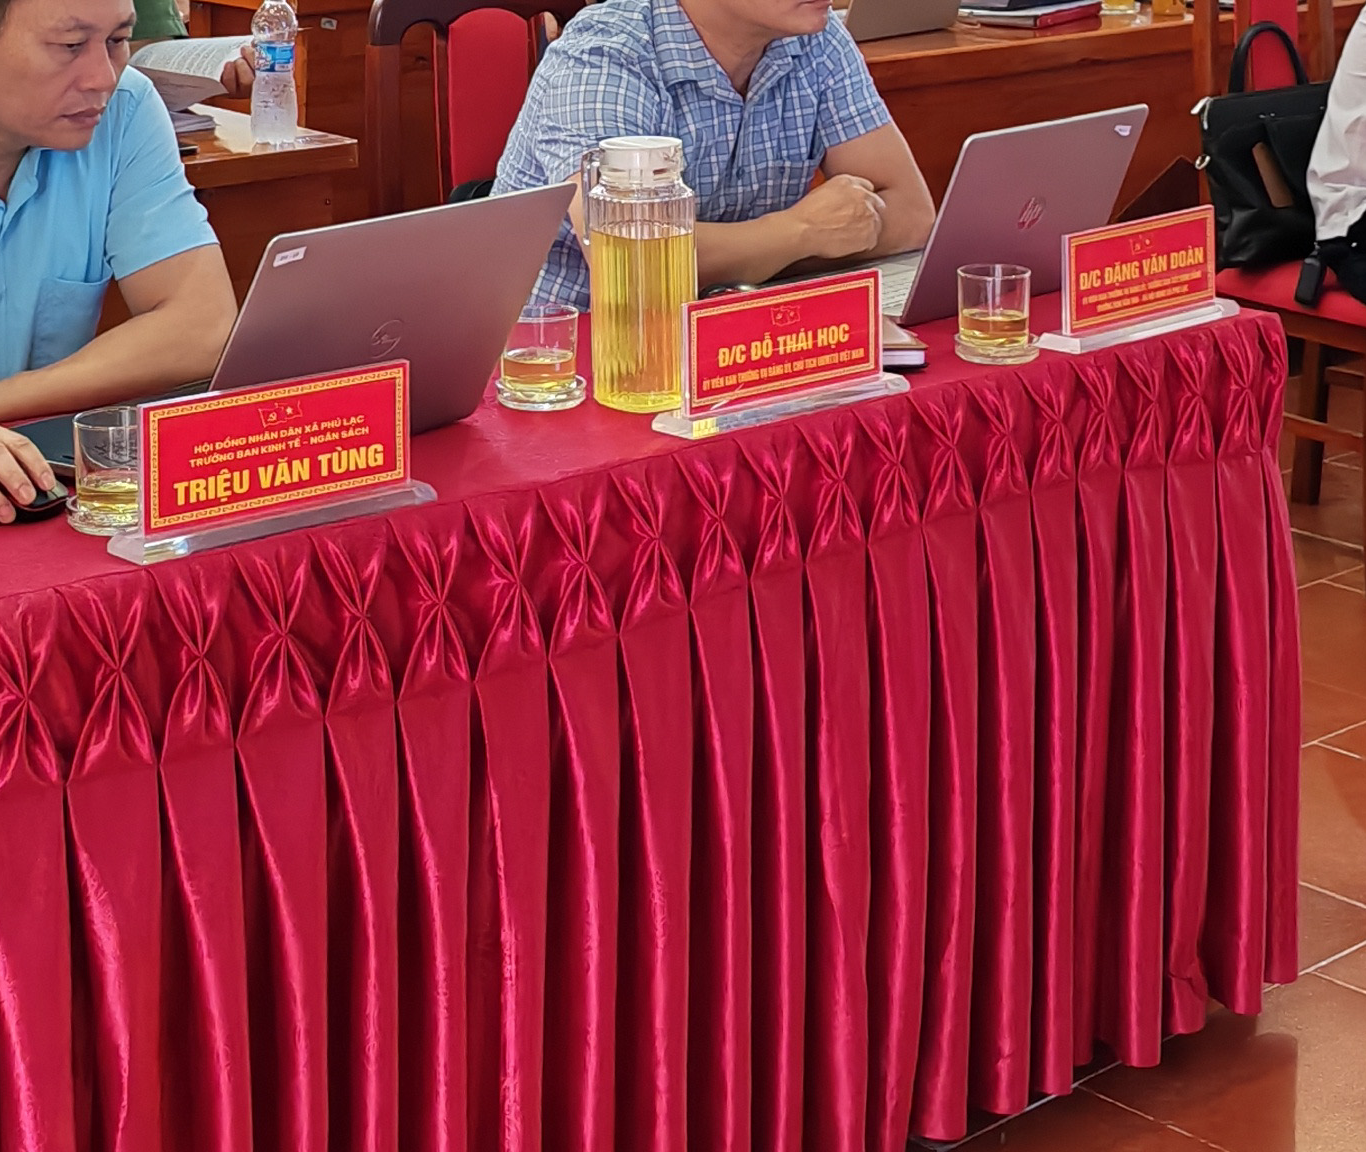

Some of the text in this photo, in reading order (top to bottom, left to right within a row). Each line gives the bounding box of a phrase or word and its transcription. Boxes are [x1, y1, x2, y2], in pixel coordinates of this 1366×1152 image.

[1079, 269, 1101, 290] Đ/C
[1104, 261, 1140, 286] ĐẶNG
[1142, 253, 1168, 276] VĂN
[718, 323, 850, 368] Đ/C ĐỖ THÁI HỌC
[193, 440, 214, 455] HỘI
[215, 435, 247, 450] ĐỒNG
[248, 430, 278, 444] NHÂN
[280, 426, 302, 438] DÂN
[304, 421, 319, 433] XÃ
[343, 415, 365, 428] LẠC
[236, 448, 259, 459] BAN
[260, 442, 286, 455] KINH
[287, 436, 301, 449] TẾ
[341, 424, 369, 438] SÁCH
[173, 443, 384, 506] TRIỆU VĂN TÙNG
